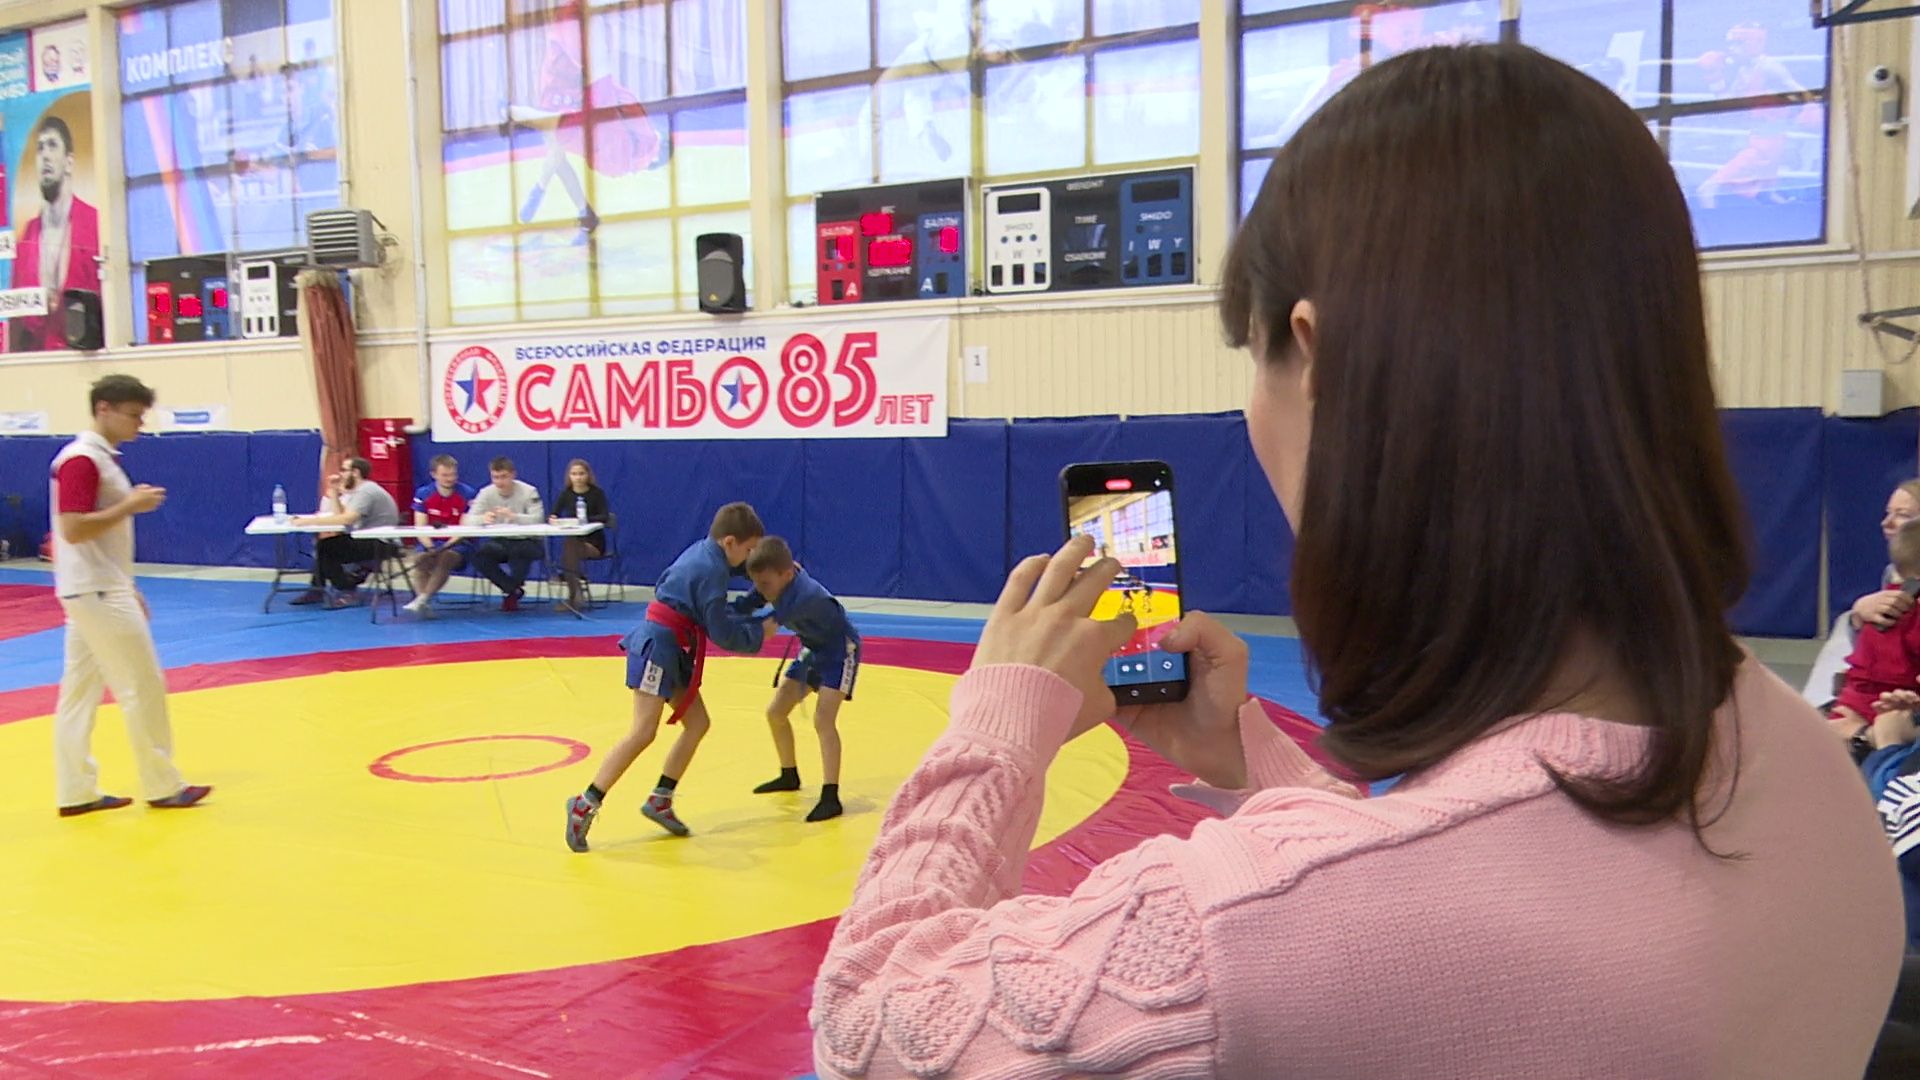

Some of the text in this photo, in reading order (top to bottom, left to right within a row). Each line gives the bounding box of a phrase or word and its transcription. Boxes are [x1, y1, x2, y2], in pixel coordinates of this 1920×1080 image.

[126, 36, 234, 83] КОМПЛЕКС
[1138, 210, 1173, 222] SHIDO
[515, 335, 767, 361] ВСЕРОССИЙСКАЯ ФЕДЕРАЦИЯ
[515, 356, 769, 431] САМБО
[777, 331, 877, 429] 85
[874, 394, 934, 426] ЛЕТ
